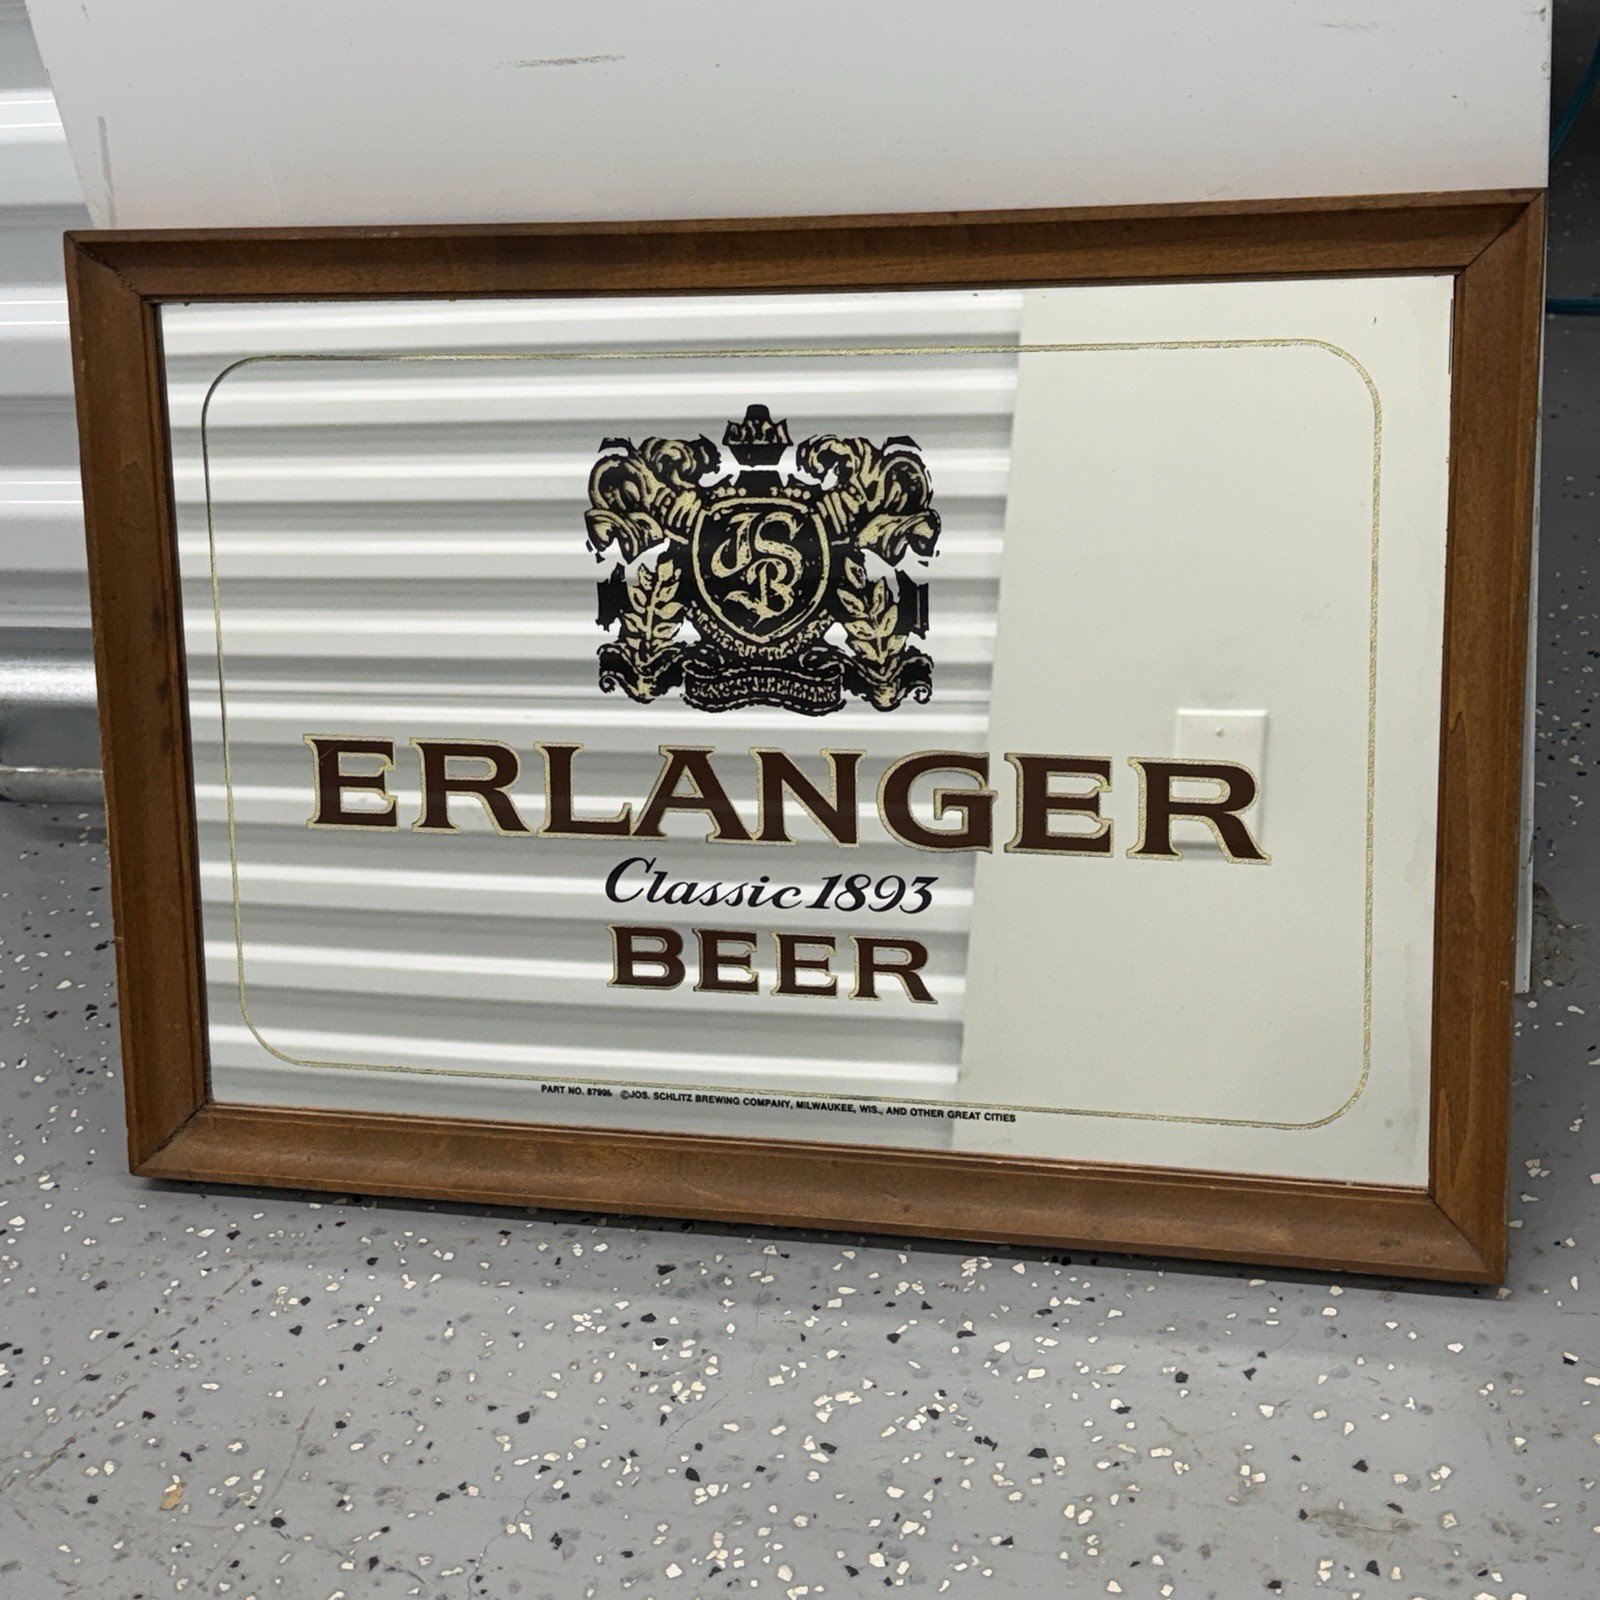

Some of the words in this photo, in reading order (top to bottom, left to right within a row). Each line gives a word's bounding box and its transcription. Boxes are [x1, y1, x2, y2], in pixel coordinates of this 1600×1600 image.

[303, 734, 1272, 866] ERLANGER
[605, 857, 801, 910] Classic
[805, 873, 939, 914] 1893
[607, 924, 938, 1004] BEER
[541, 1084, 565, 1095] PART
[568, 1086, 584, 1096] NO.
[653, 1091, 693, 1102] SCHLITZ
[695, 1094, 740, 1106] BREWING
[743, 1097, 793, 1110] COMPANY,
[796, 1100, 856, 1114] MILWAUKEE,
[886, 1106, 907, 1116] AND
[910, 1108, 944, 1119] OTHER
[947, 1111, 981, 1121] GREAT
[984, 1113, 1017, 1123] CITIES
